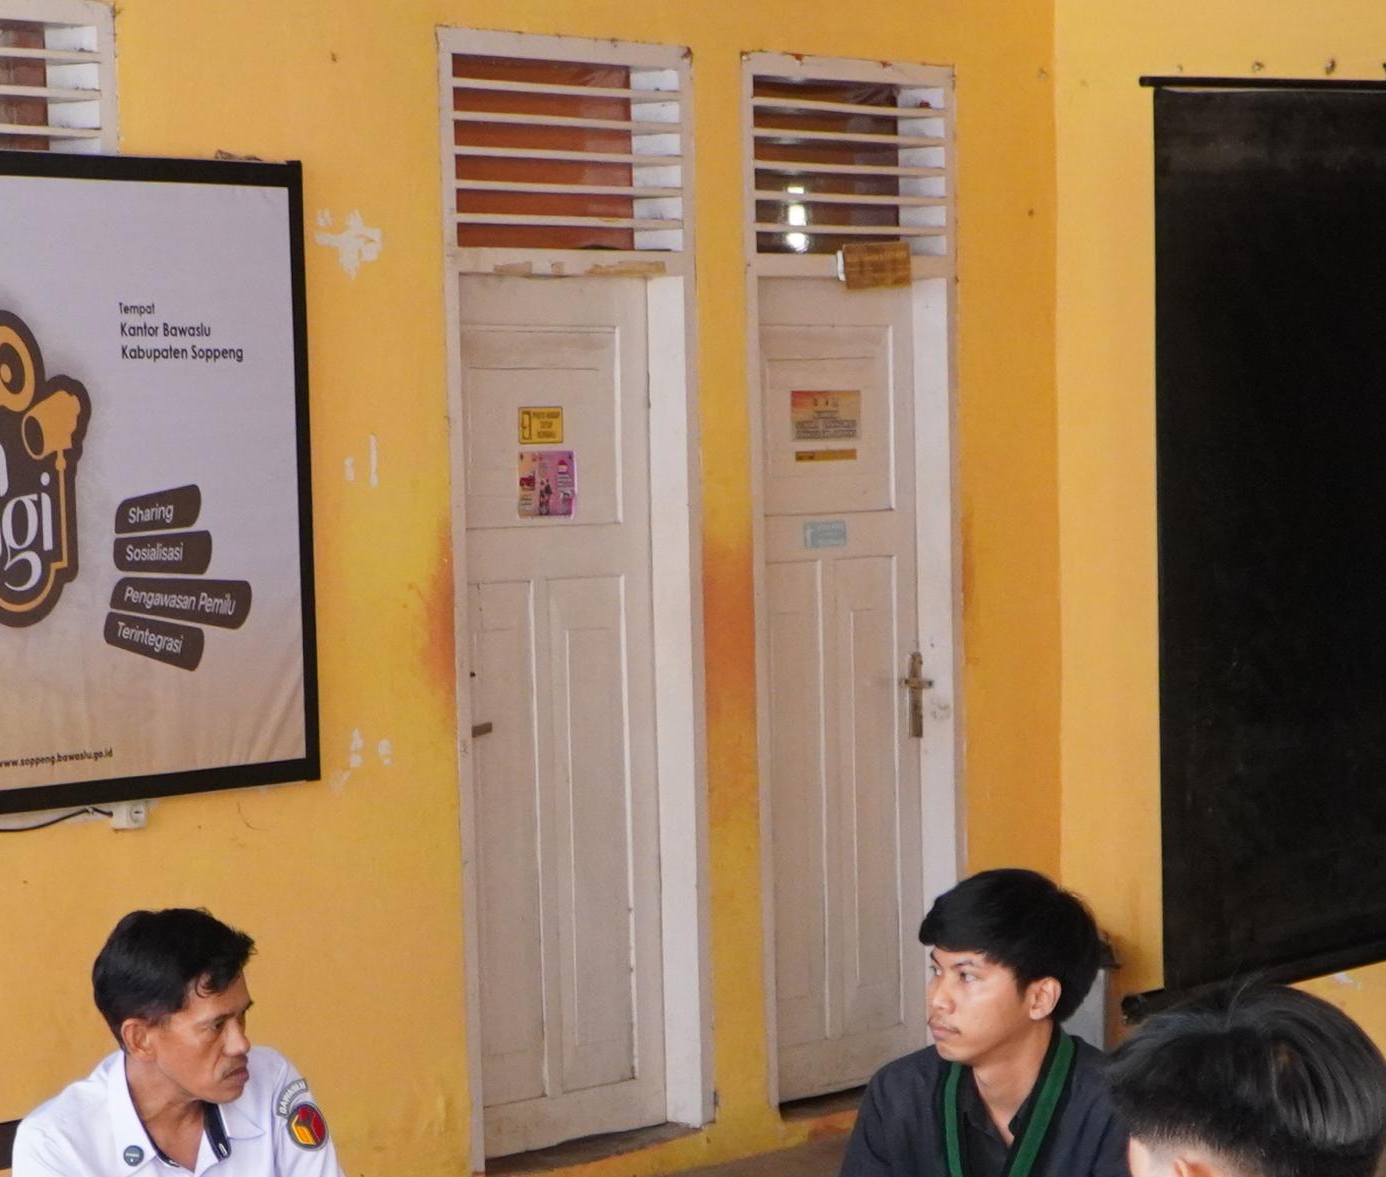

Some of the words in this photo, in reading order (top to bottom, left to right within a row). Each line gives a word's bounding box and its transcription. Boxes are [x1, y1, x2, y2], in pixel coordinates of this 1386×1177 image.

[119, 302, 156, 316] Tempat
[120, 322, 159, 337] Kantor
[163, 322, 211, 337] Bawaslu
[121, 345, 188, 362] Kabupaten
[191, 345, 244, 363] Soppeng
[128, 503, 174, 524] Sharing
[125, 542, 184, 562] Sosialisasi
[124, 586, 197, 610] Pengawasan
[198, 592, 237, 615] Pemilu
[117, 621, 184, 654] Terintegrasi
